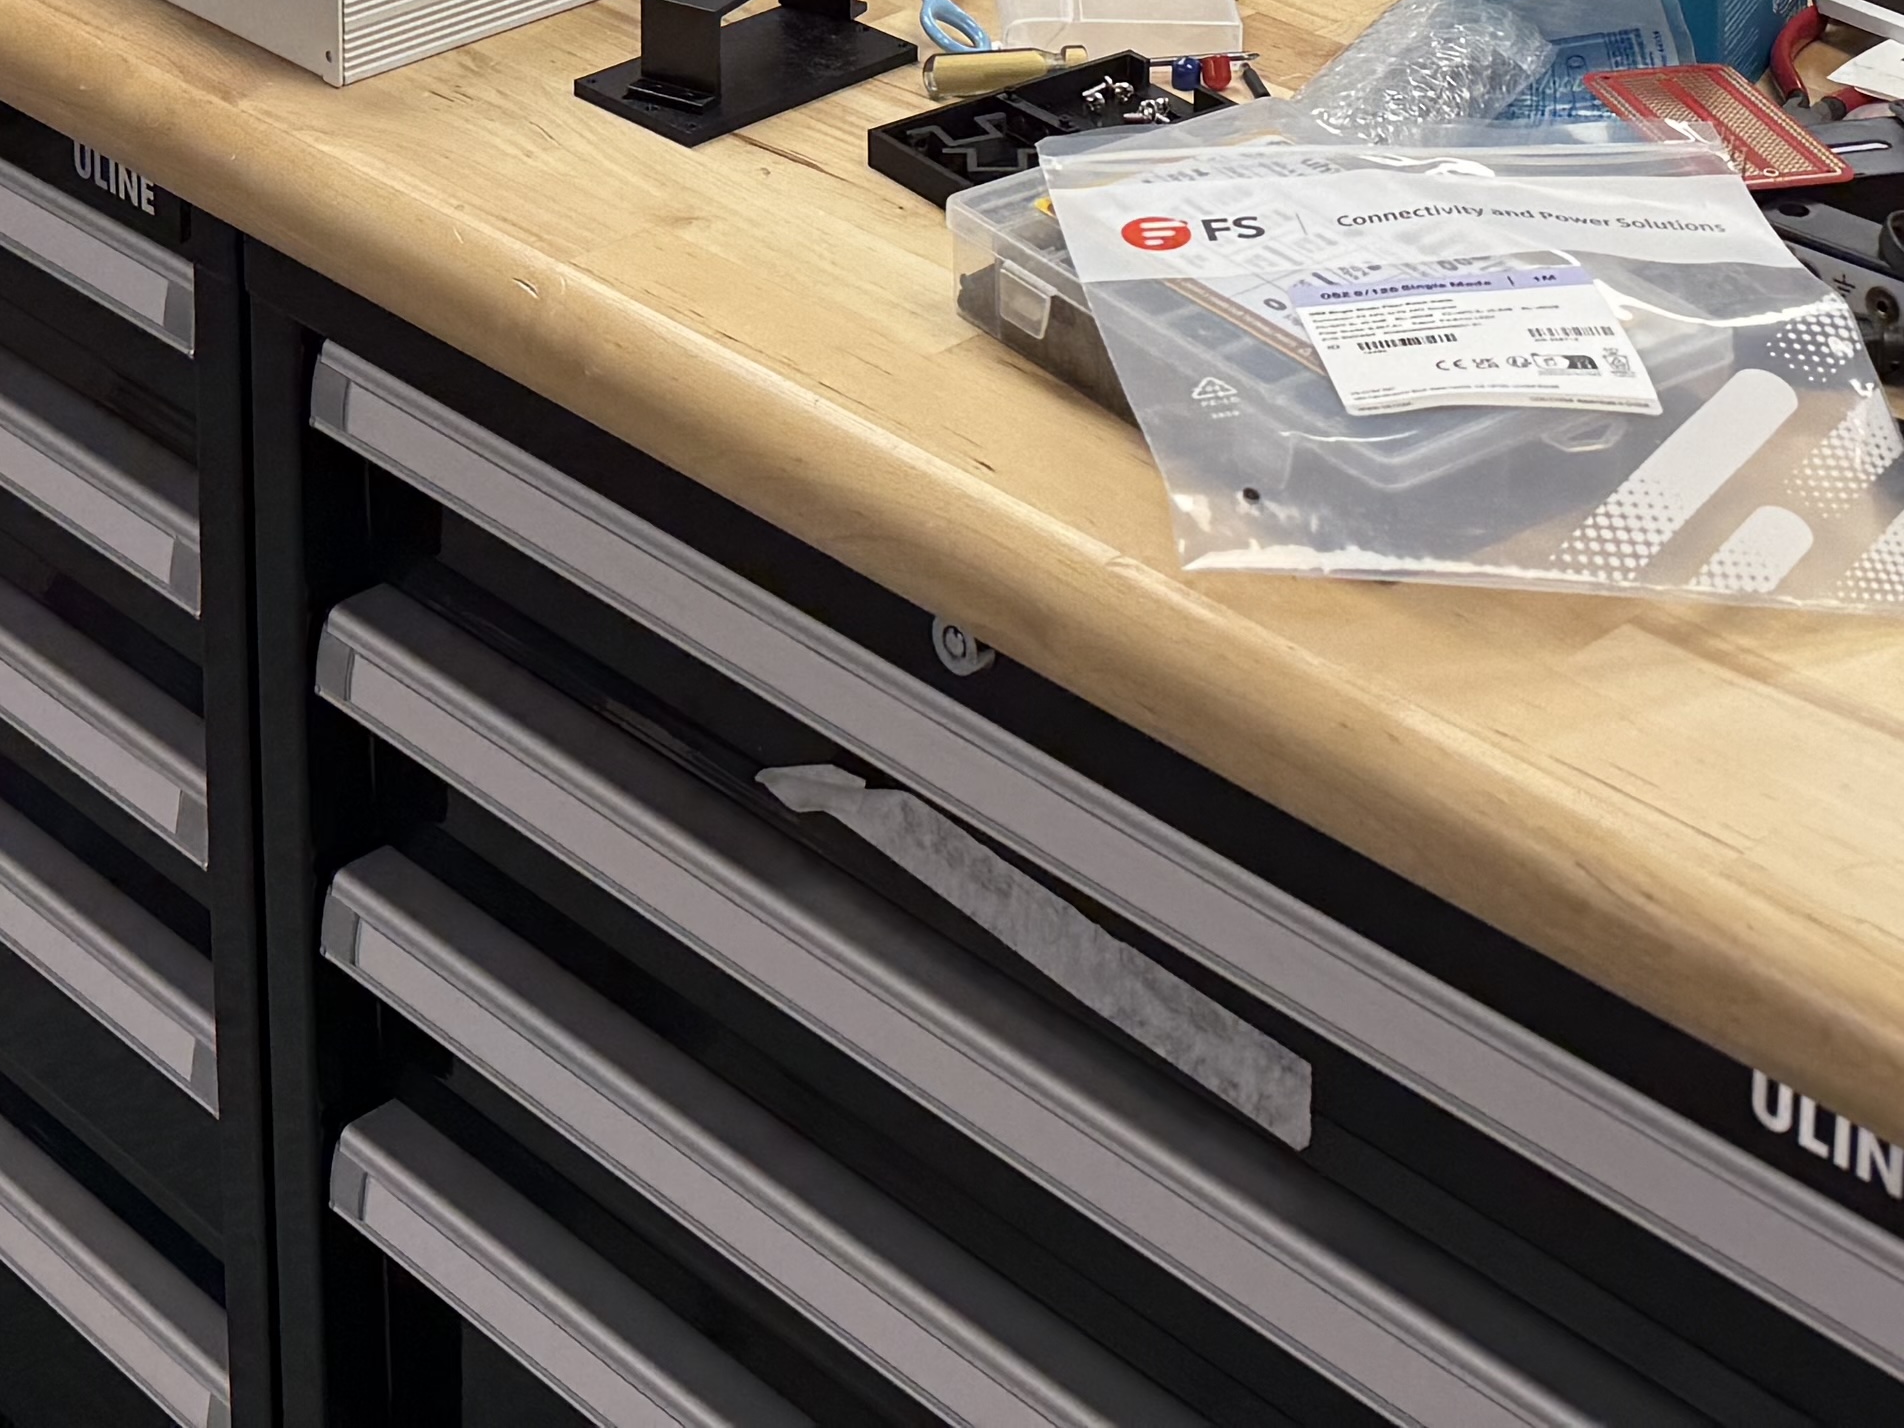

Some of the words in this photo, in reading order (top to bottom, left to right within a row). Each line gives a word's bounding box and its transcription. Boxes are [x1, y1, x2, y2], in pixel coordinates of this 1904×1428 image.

[74, 140, 156, 216] ULINE
[1201, 216, 1267, 242] FS
[1336, 203, 1484, 229] Connectivity
[1490, 206, 1536, 221] and
[1539, 210, 1611, 231] Power
[1615, 214, 1729, 236] Solutions
